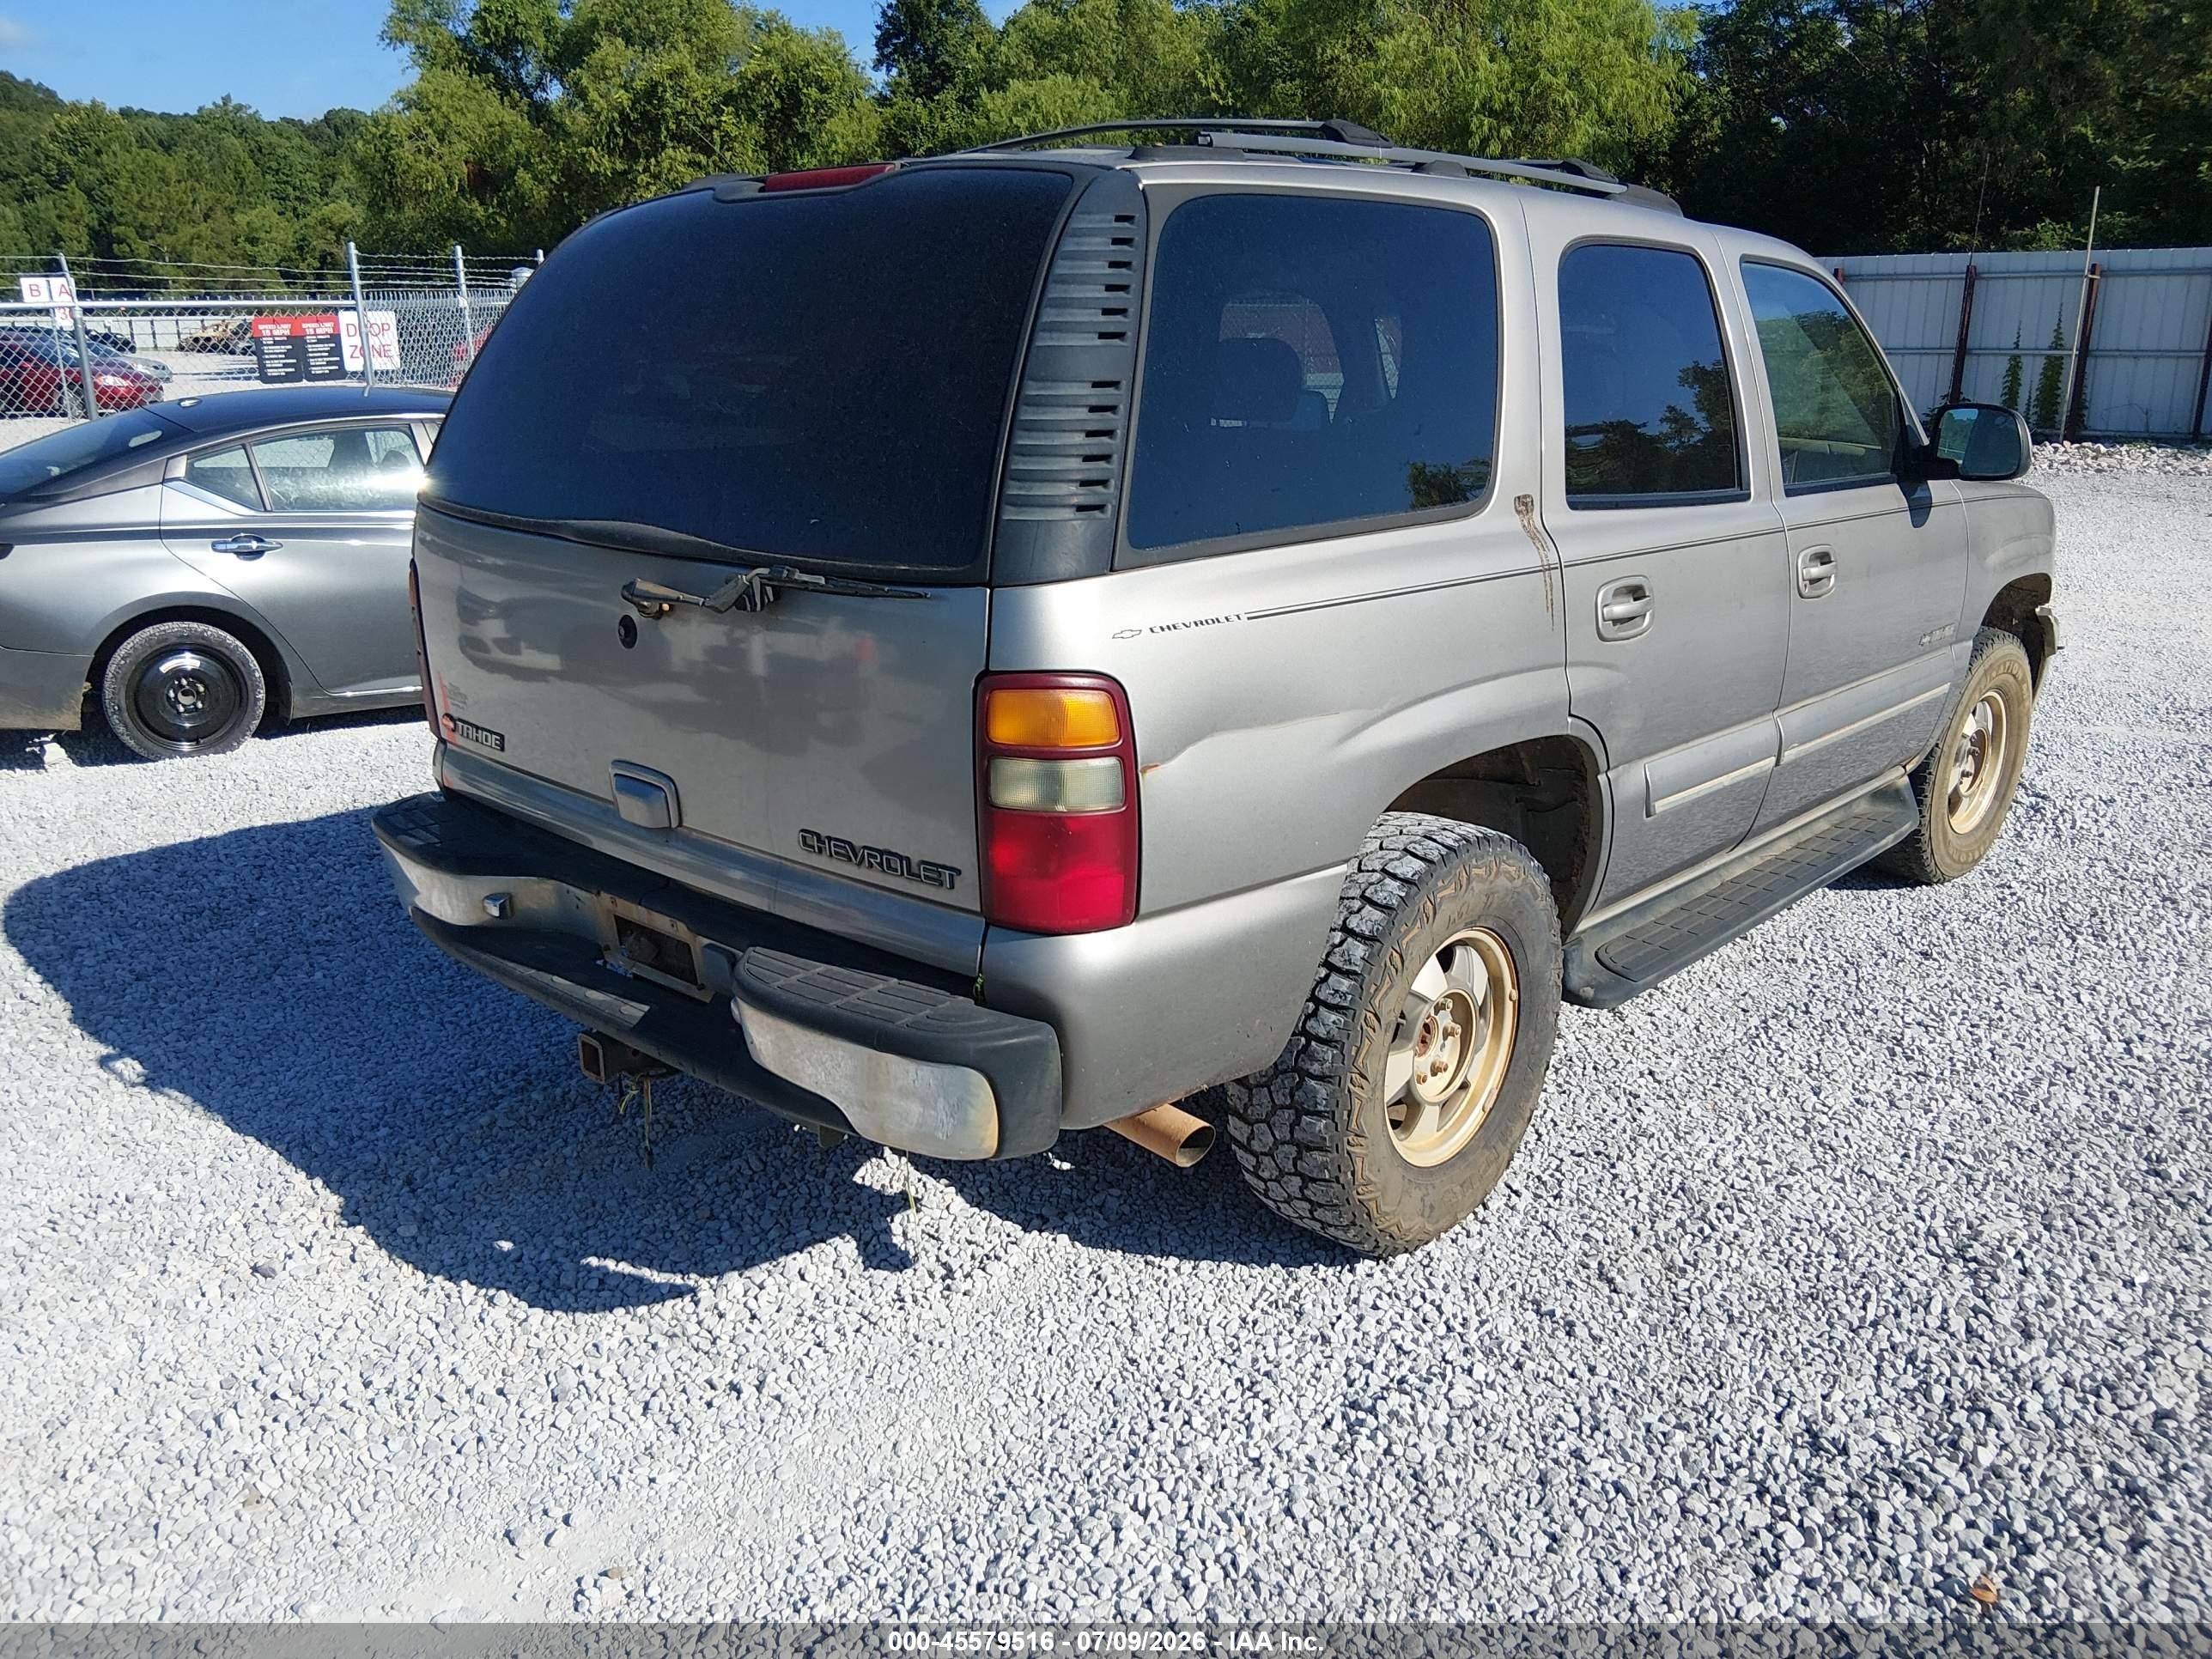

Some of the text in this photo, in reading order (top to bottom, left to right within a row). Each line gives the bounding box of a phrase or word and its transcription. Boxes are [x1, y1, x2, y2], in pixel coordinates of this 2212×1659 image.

[28, 284, 41, 297] B
[58, 283, 72, 297] A
[346, 322, 391, 337] DOP
[1149, 613, 1242, 634] CHEVROLET
[456, 718, 505, 752] TAHOE
[799, 828, 962, 890] CHEVROLET
